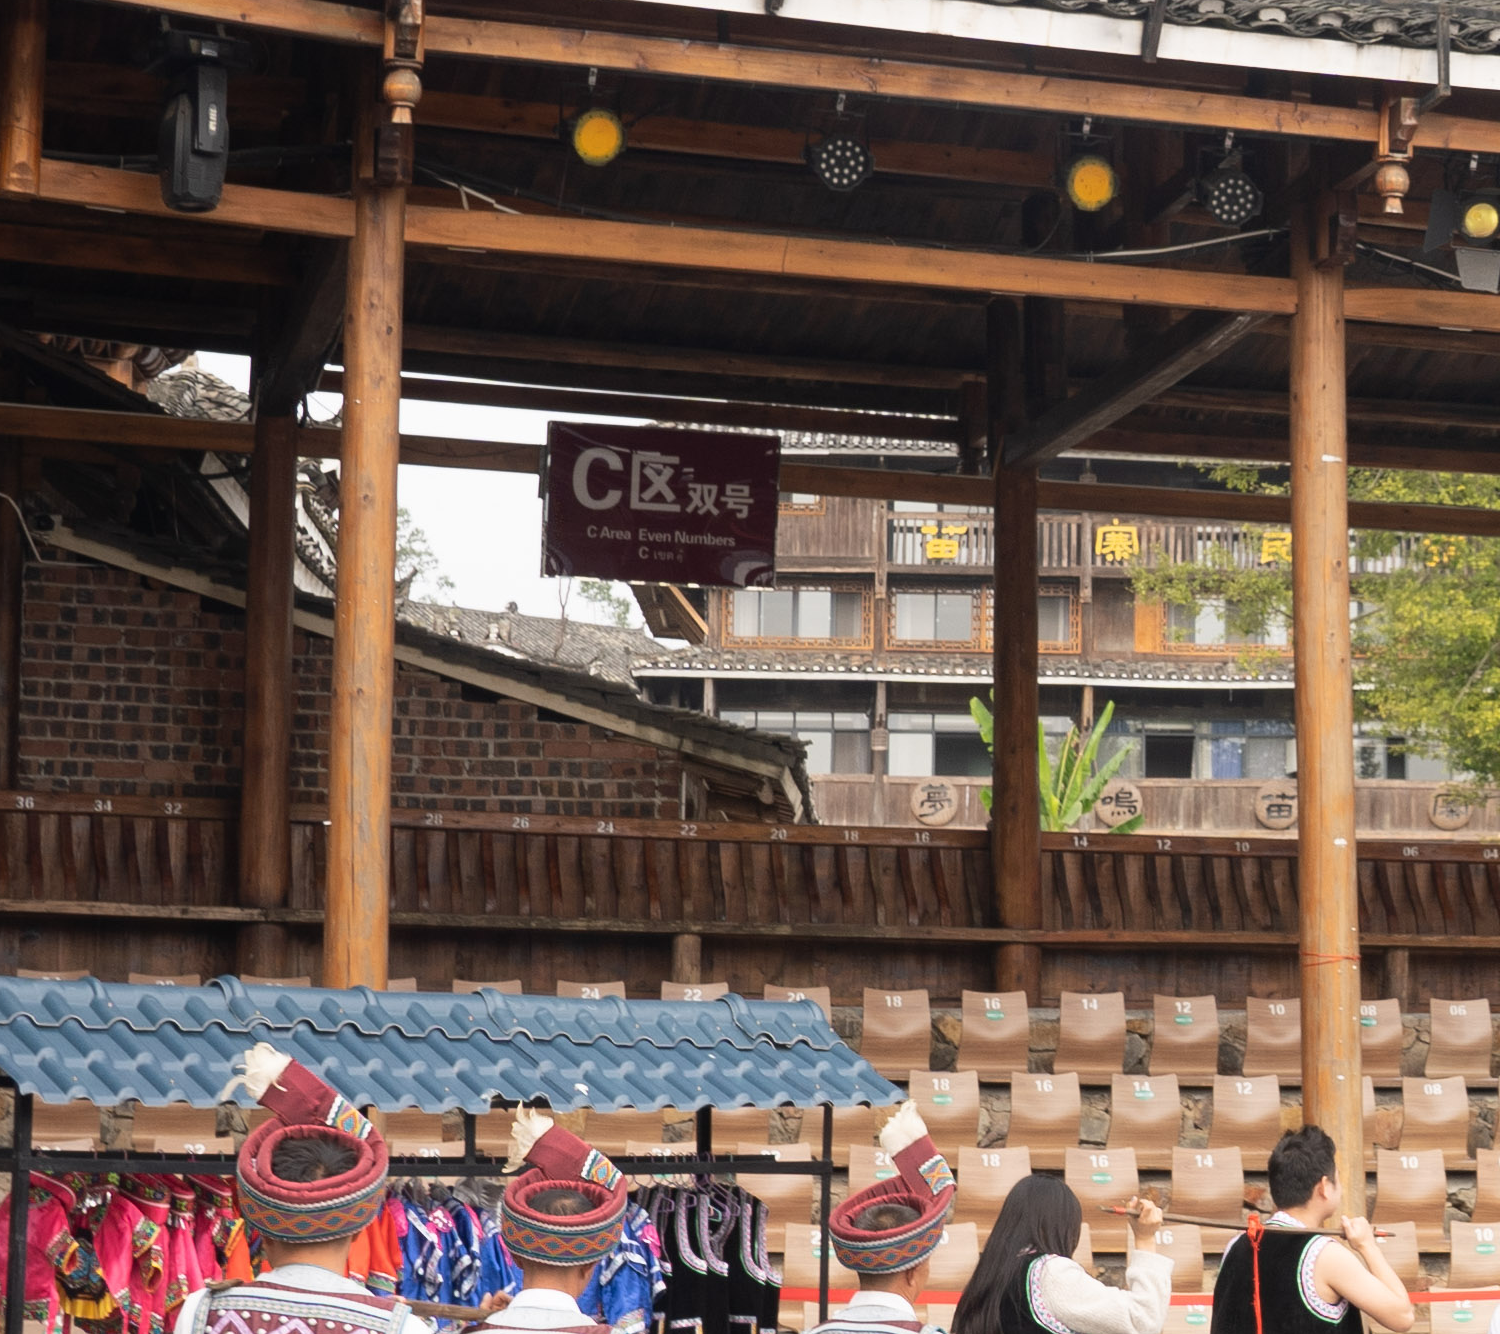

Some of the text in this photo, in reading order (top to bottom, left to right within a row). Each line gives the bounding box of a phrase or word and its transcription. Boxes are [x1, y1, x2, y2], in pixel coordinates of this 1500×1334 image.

[572, 447, 755, 520] C区双号
[587, 525, 736, 547] C Area Even Numbers
[921, 525, 967, 559] 苗
[1095, 517, 1139, 561] 寨
[16, 796, 34, 808] 36
[94, 800, 112, 812] 34
[165, 802, 182, 814] 32
[422, 813, 443, 826] 28
[512, 817, 530, 828] 26
[597, 821, 614, 833] 24
[680, 824, 697, 837] 22
[771, 828, 787, 840] 20
[844, 830, 859, 842] 18
[1074, 836, 1088, 848] 14
[1157, 839, 1171, 850] 12
[1236, 842, 1250, 852] 10
[1483, 849, 1499, 859] 04
[885, 996, 902, 1007] 18
[984, 998, 1001, 1010] 16
[1082, 998, 1098, 1010] 14
[1175, 1001, 1191, 1013] 12
[1269, 1004, 1285, 1015] 10
[932, 1078, 950, 1091] 18
[1036, 1080, 1053, 1092] 16
[1236, 1082, 1252, 1094] 12
[981, 1154, 1000, 1166] 18
[1090, 1155, 1109, 1167] 16
[1195, 1155, 1213, 1167] 14
[1400, 1156, 1418, 1168] 10
[1475, 1228, 1494, 1241] 10
